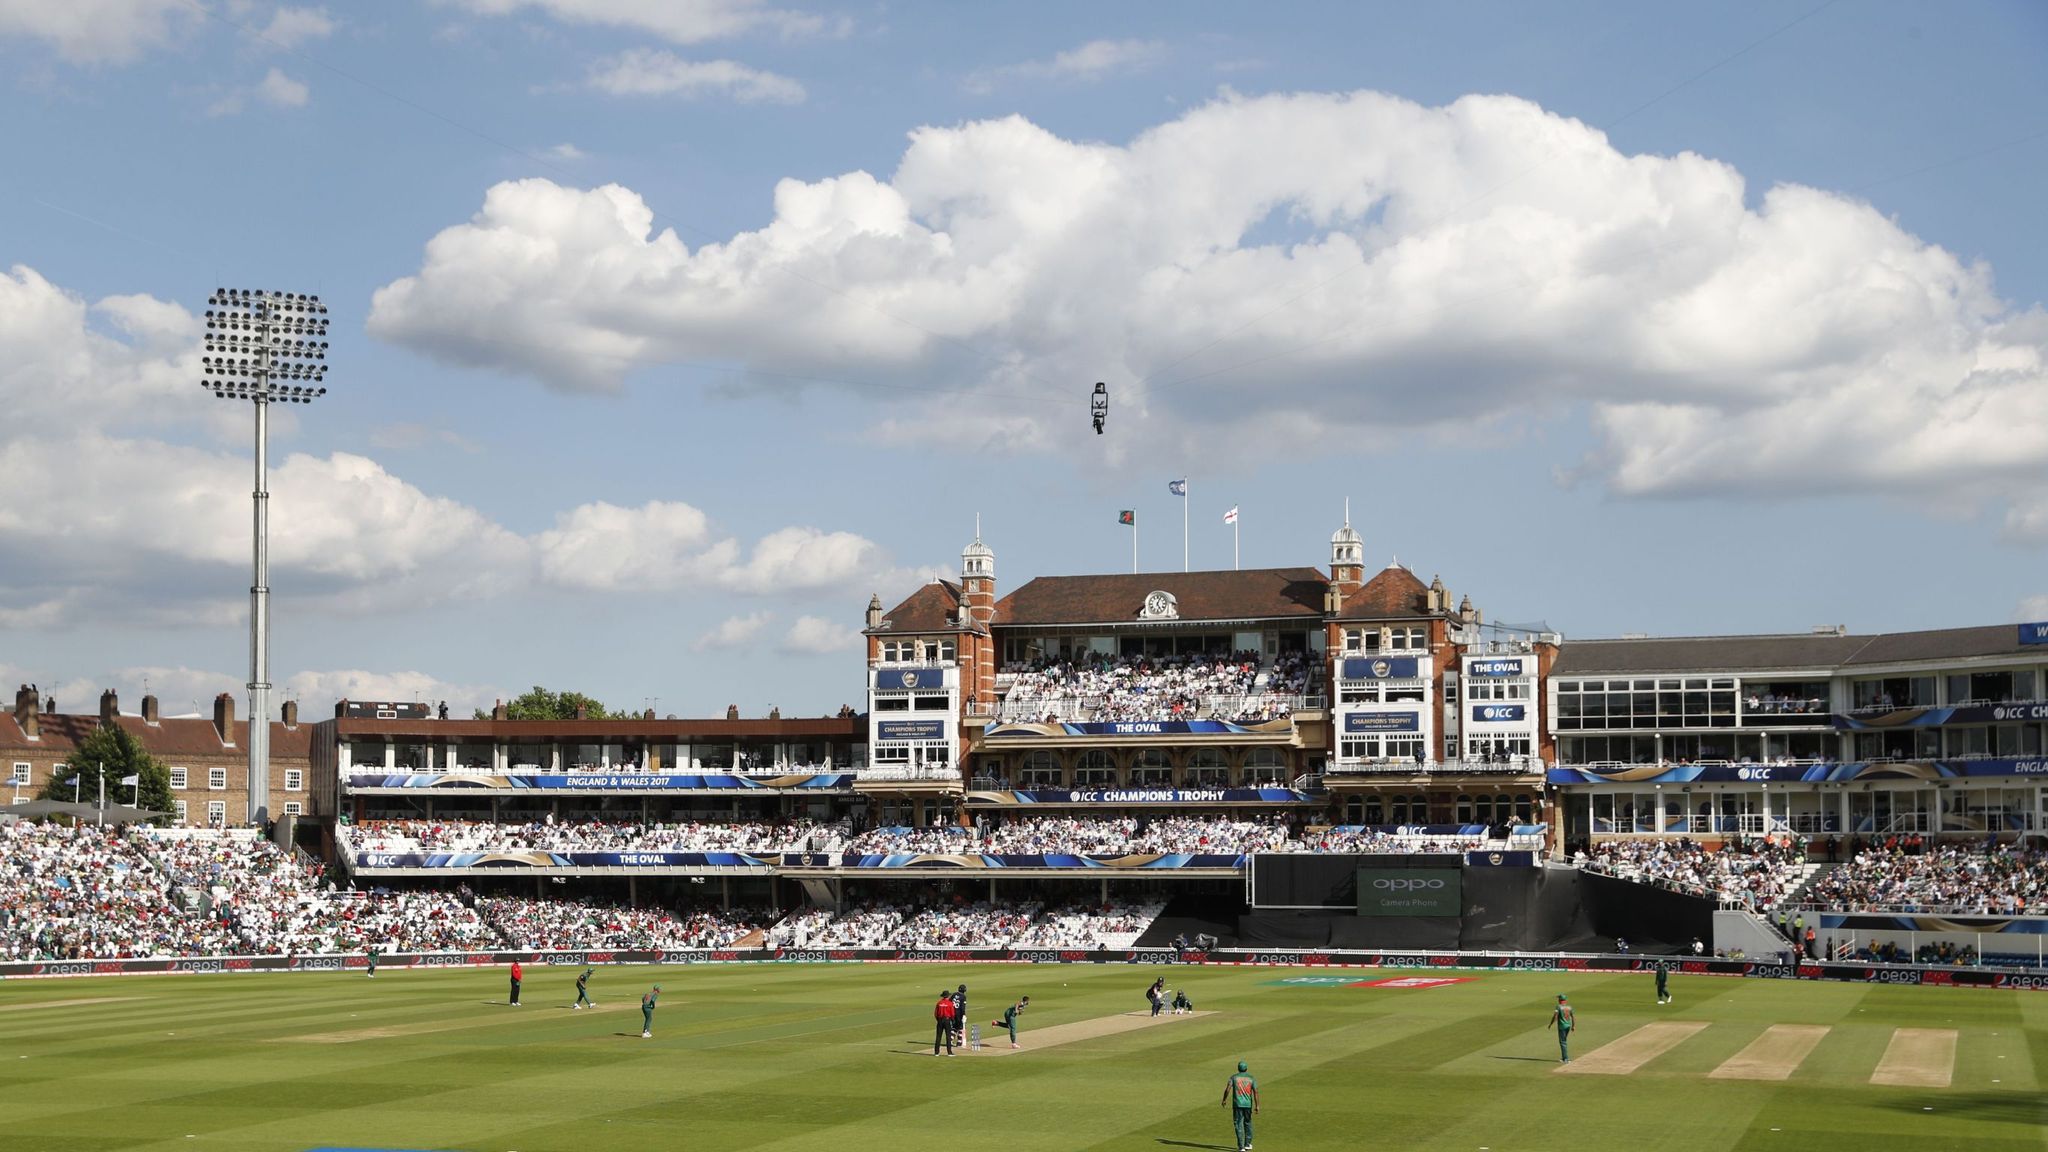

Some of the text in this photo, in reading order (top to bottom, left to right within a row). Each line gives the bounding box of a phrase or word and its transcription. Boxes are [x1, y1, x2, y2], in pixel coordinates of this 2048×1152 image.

[1474, 662, 1520, 672] THE OVAL
[1495, 708, 1513, 718] ICC
[2006, 707, 2025, 719] ICC
[1116, 723, 1162, 733] THE OVAL
[2015, 761, 2048, 773] ENGLA
[1750, 768, 1771, 779] ICC
[567, 777, 669, 786] ENGLAND & WALES 2017
[1081, 790, 1225, 802] ICC CHAMPIONS TROPHY
[1407, 826, 1428, 835] ICC
[377, 855, 396, 865] ICC
[620, 854, 666, 864] THE OVAL
[1373, 878, 1445, 892] oppo
[1381, 898, 1438, 907] Camera Phone
[426, 955, 464, 966] pepsi
[547, 952, 584, 965] pepsi
[670, 952, 708, 963] pepsi
[789, 950, 826, 961] pepsi
[908, 950, 944, 961] pepsi
[1021, 950, 1058, 962] pepsi
[1140, 951, 1179, 962] pepsi
[1261, 953, 1299, 965] pepsi
[1388, 955, 1427, 966] pepsi
[50, 962, 92, 974] pepsi
[183, 960, 222, 971] pepsi
[304, 957, 342, 968] pepsi
[1514, 957, 1556, 969] pepsi
[1880, 970, 1921, 982] pepsi
[2011, 975, 2048, 987] peps
